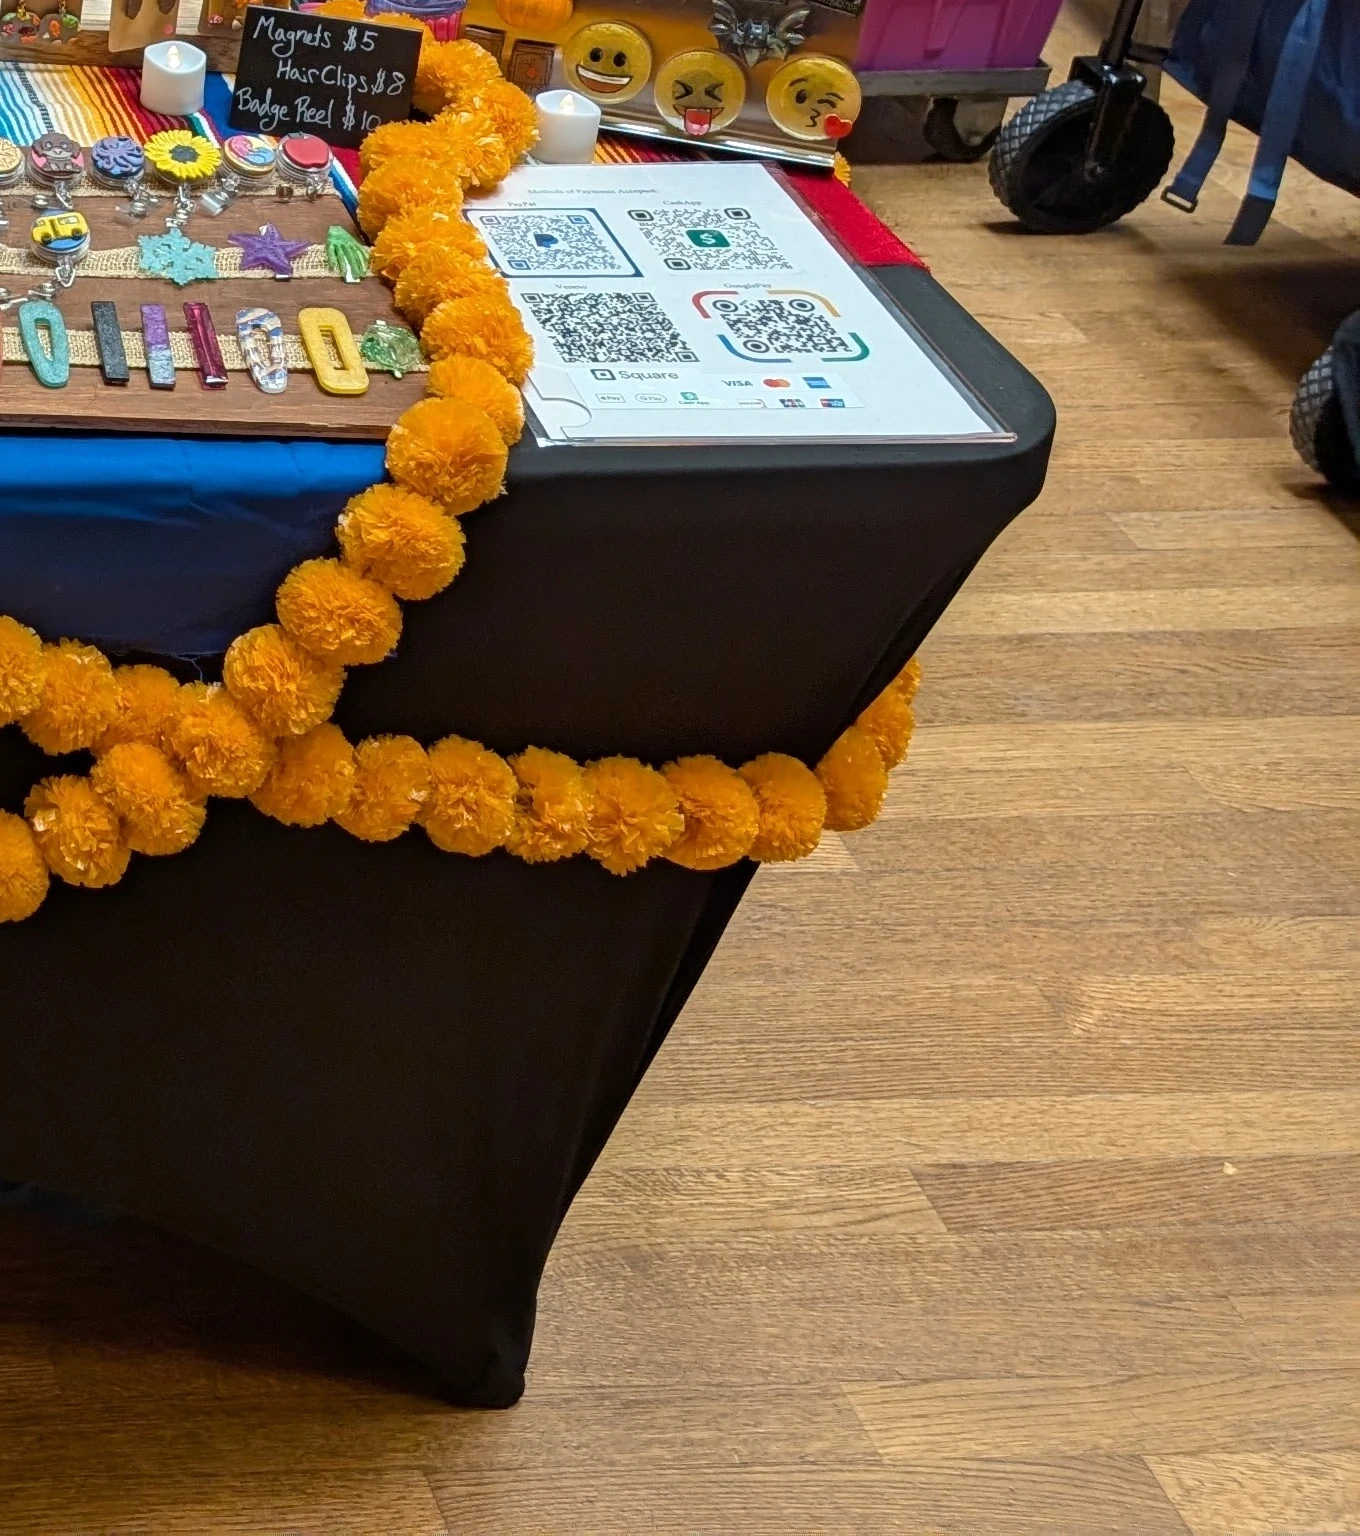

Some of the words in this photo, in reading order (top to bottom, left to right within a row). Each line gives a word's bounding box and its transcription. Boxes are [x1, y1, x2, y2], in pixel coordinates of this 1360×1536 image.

[252, 15, 332, 58] Magnets
[343, 25, 379, 52] $5
[276, 59, 320, 84] Hair
[320, 64, 369, 101] Clips
[370, 67, 406, 96] $8
[235, 86, 291, 132] Badge
[294, 95, 334, 129] Reel
[342, 98, 381, 132] $10
[528, 187, 564, 196] Methods
[507, 200, 537, 208] PayPal
[662, 199, 702, 207] CashApp
[723, 281, 773, 291] GooglePay
[619, 370, 681, 382] Square
[721, 379, 754, 388] VISA
